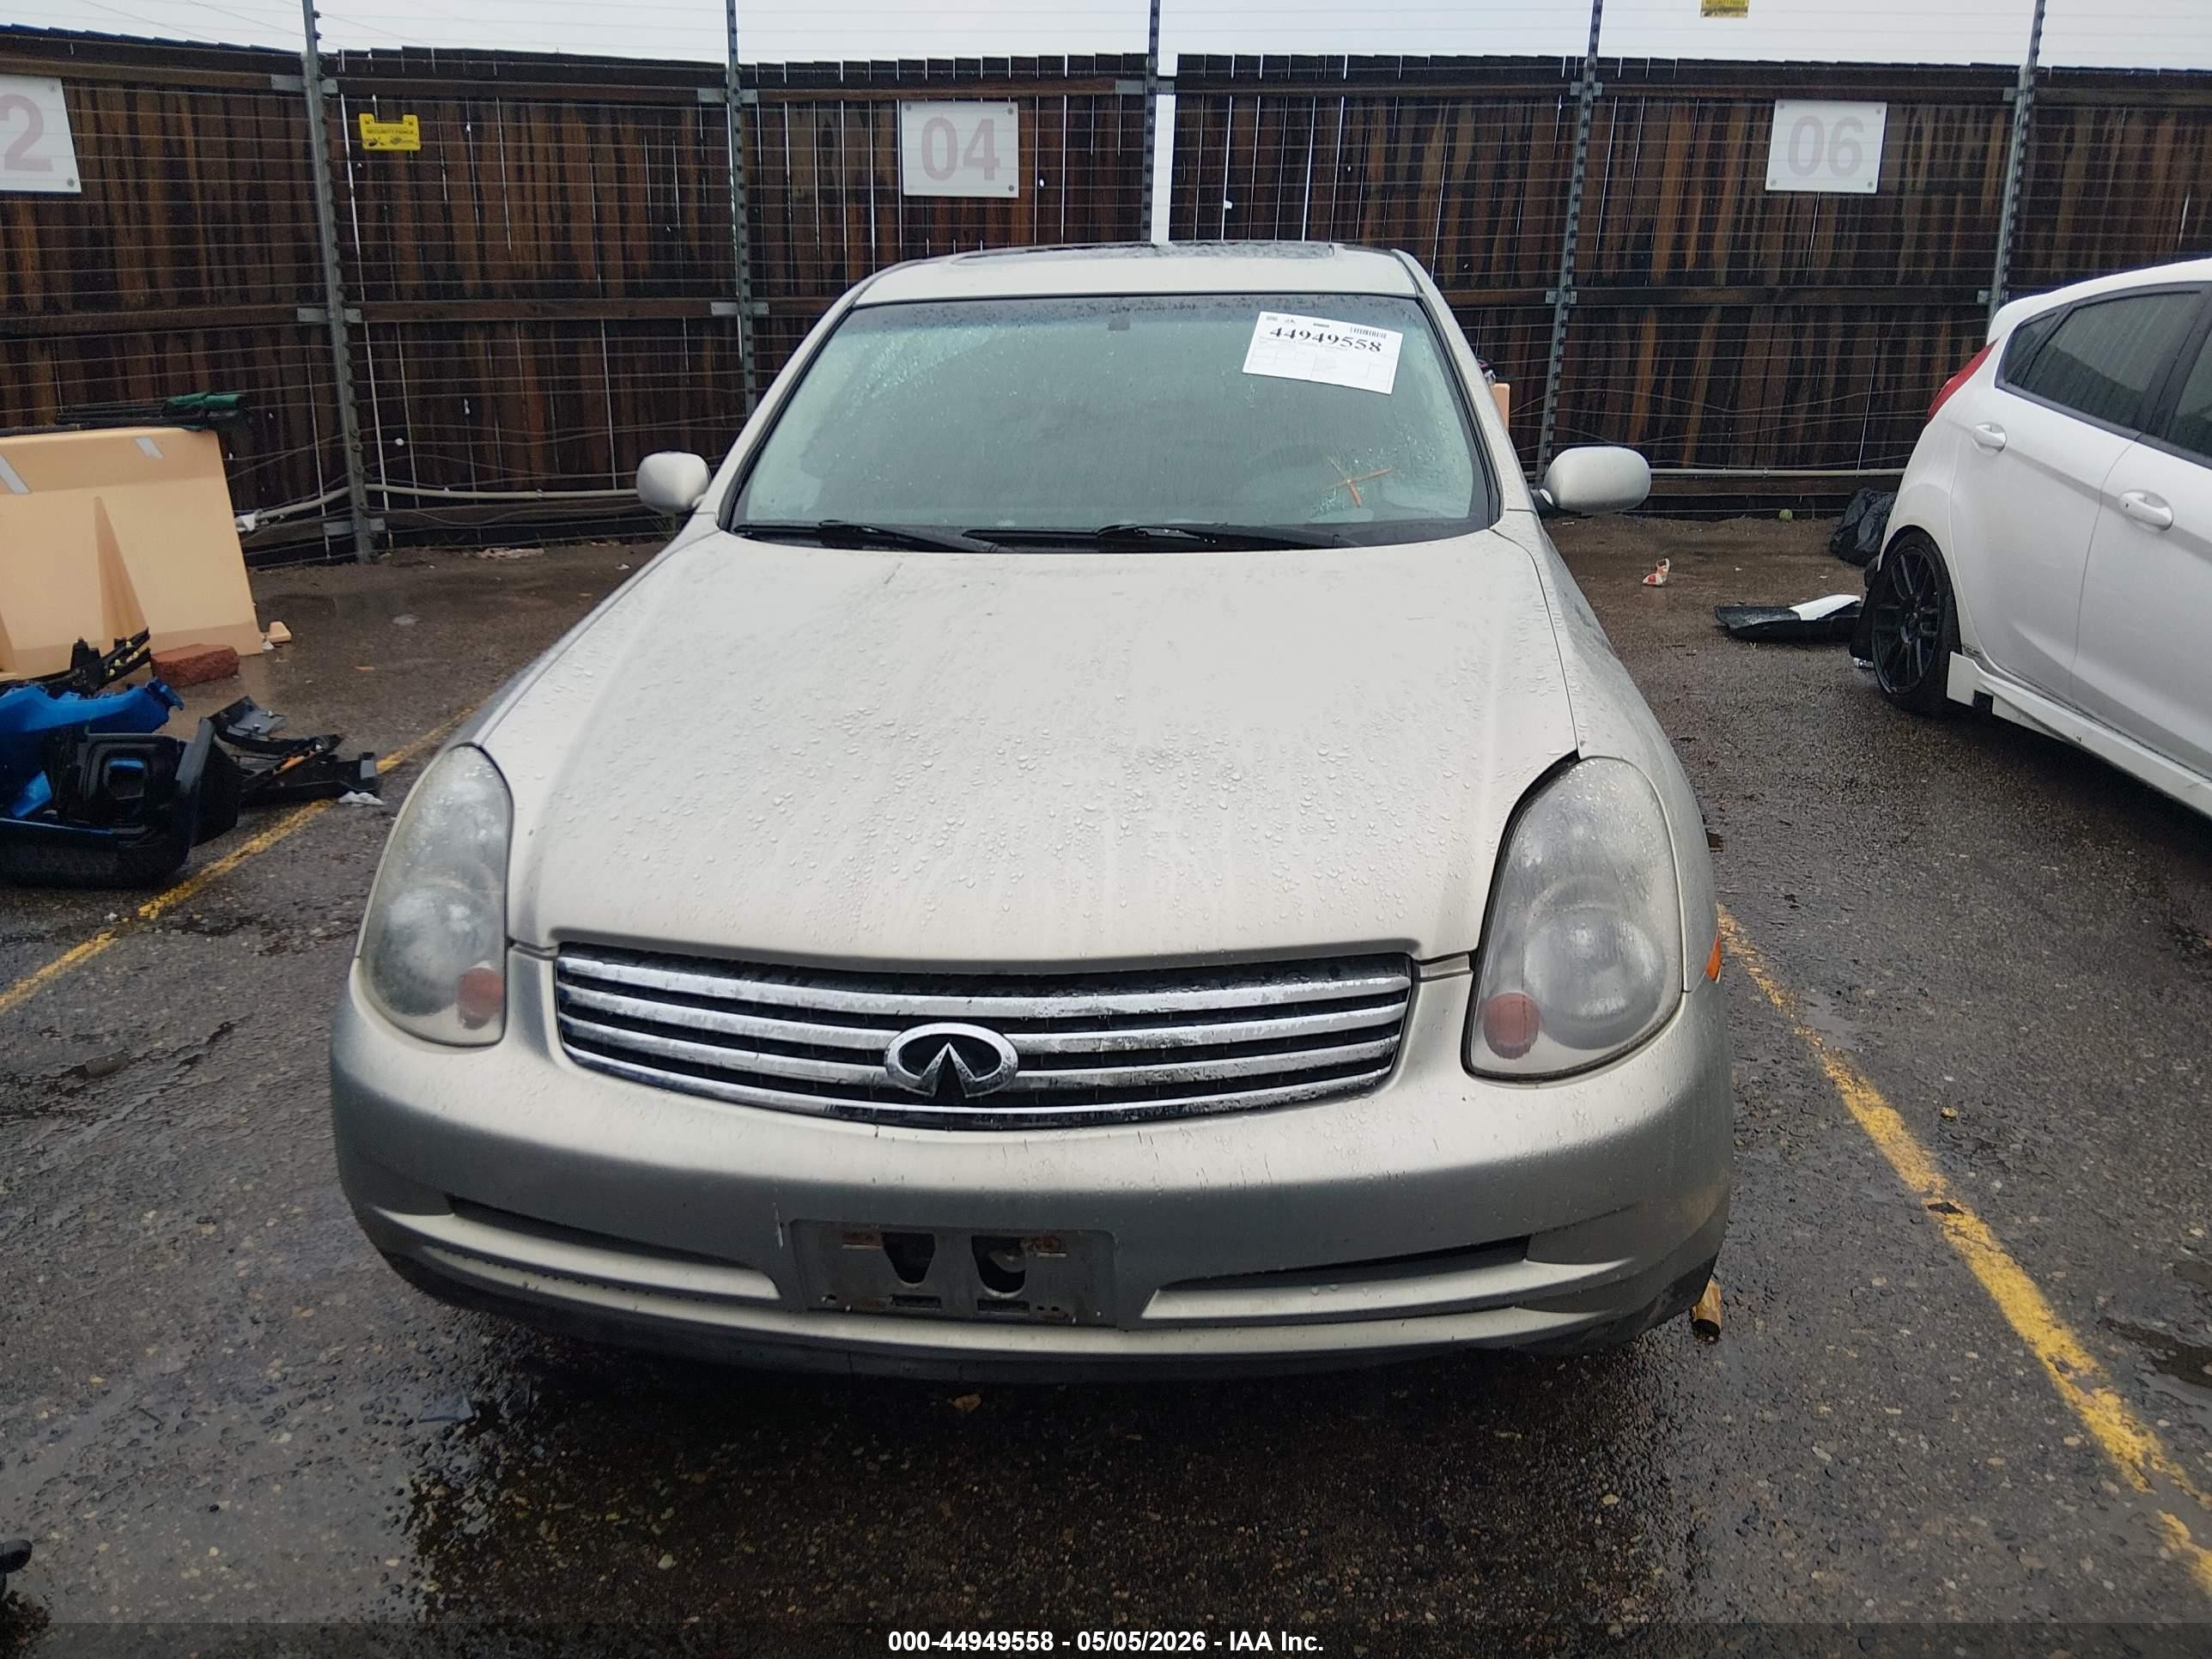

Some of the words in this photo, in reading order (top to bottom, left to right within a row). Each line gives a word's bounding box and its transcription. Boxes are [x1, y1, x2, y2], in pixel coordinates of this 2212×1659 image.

[921, 117, 1000, 181] 04
[1788, 115, 1863, 176] 06
[1269, 326, 1382, 352] 44949558
